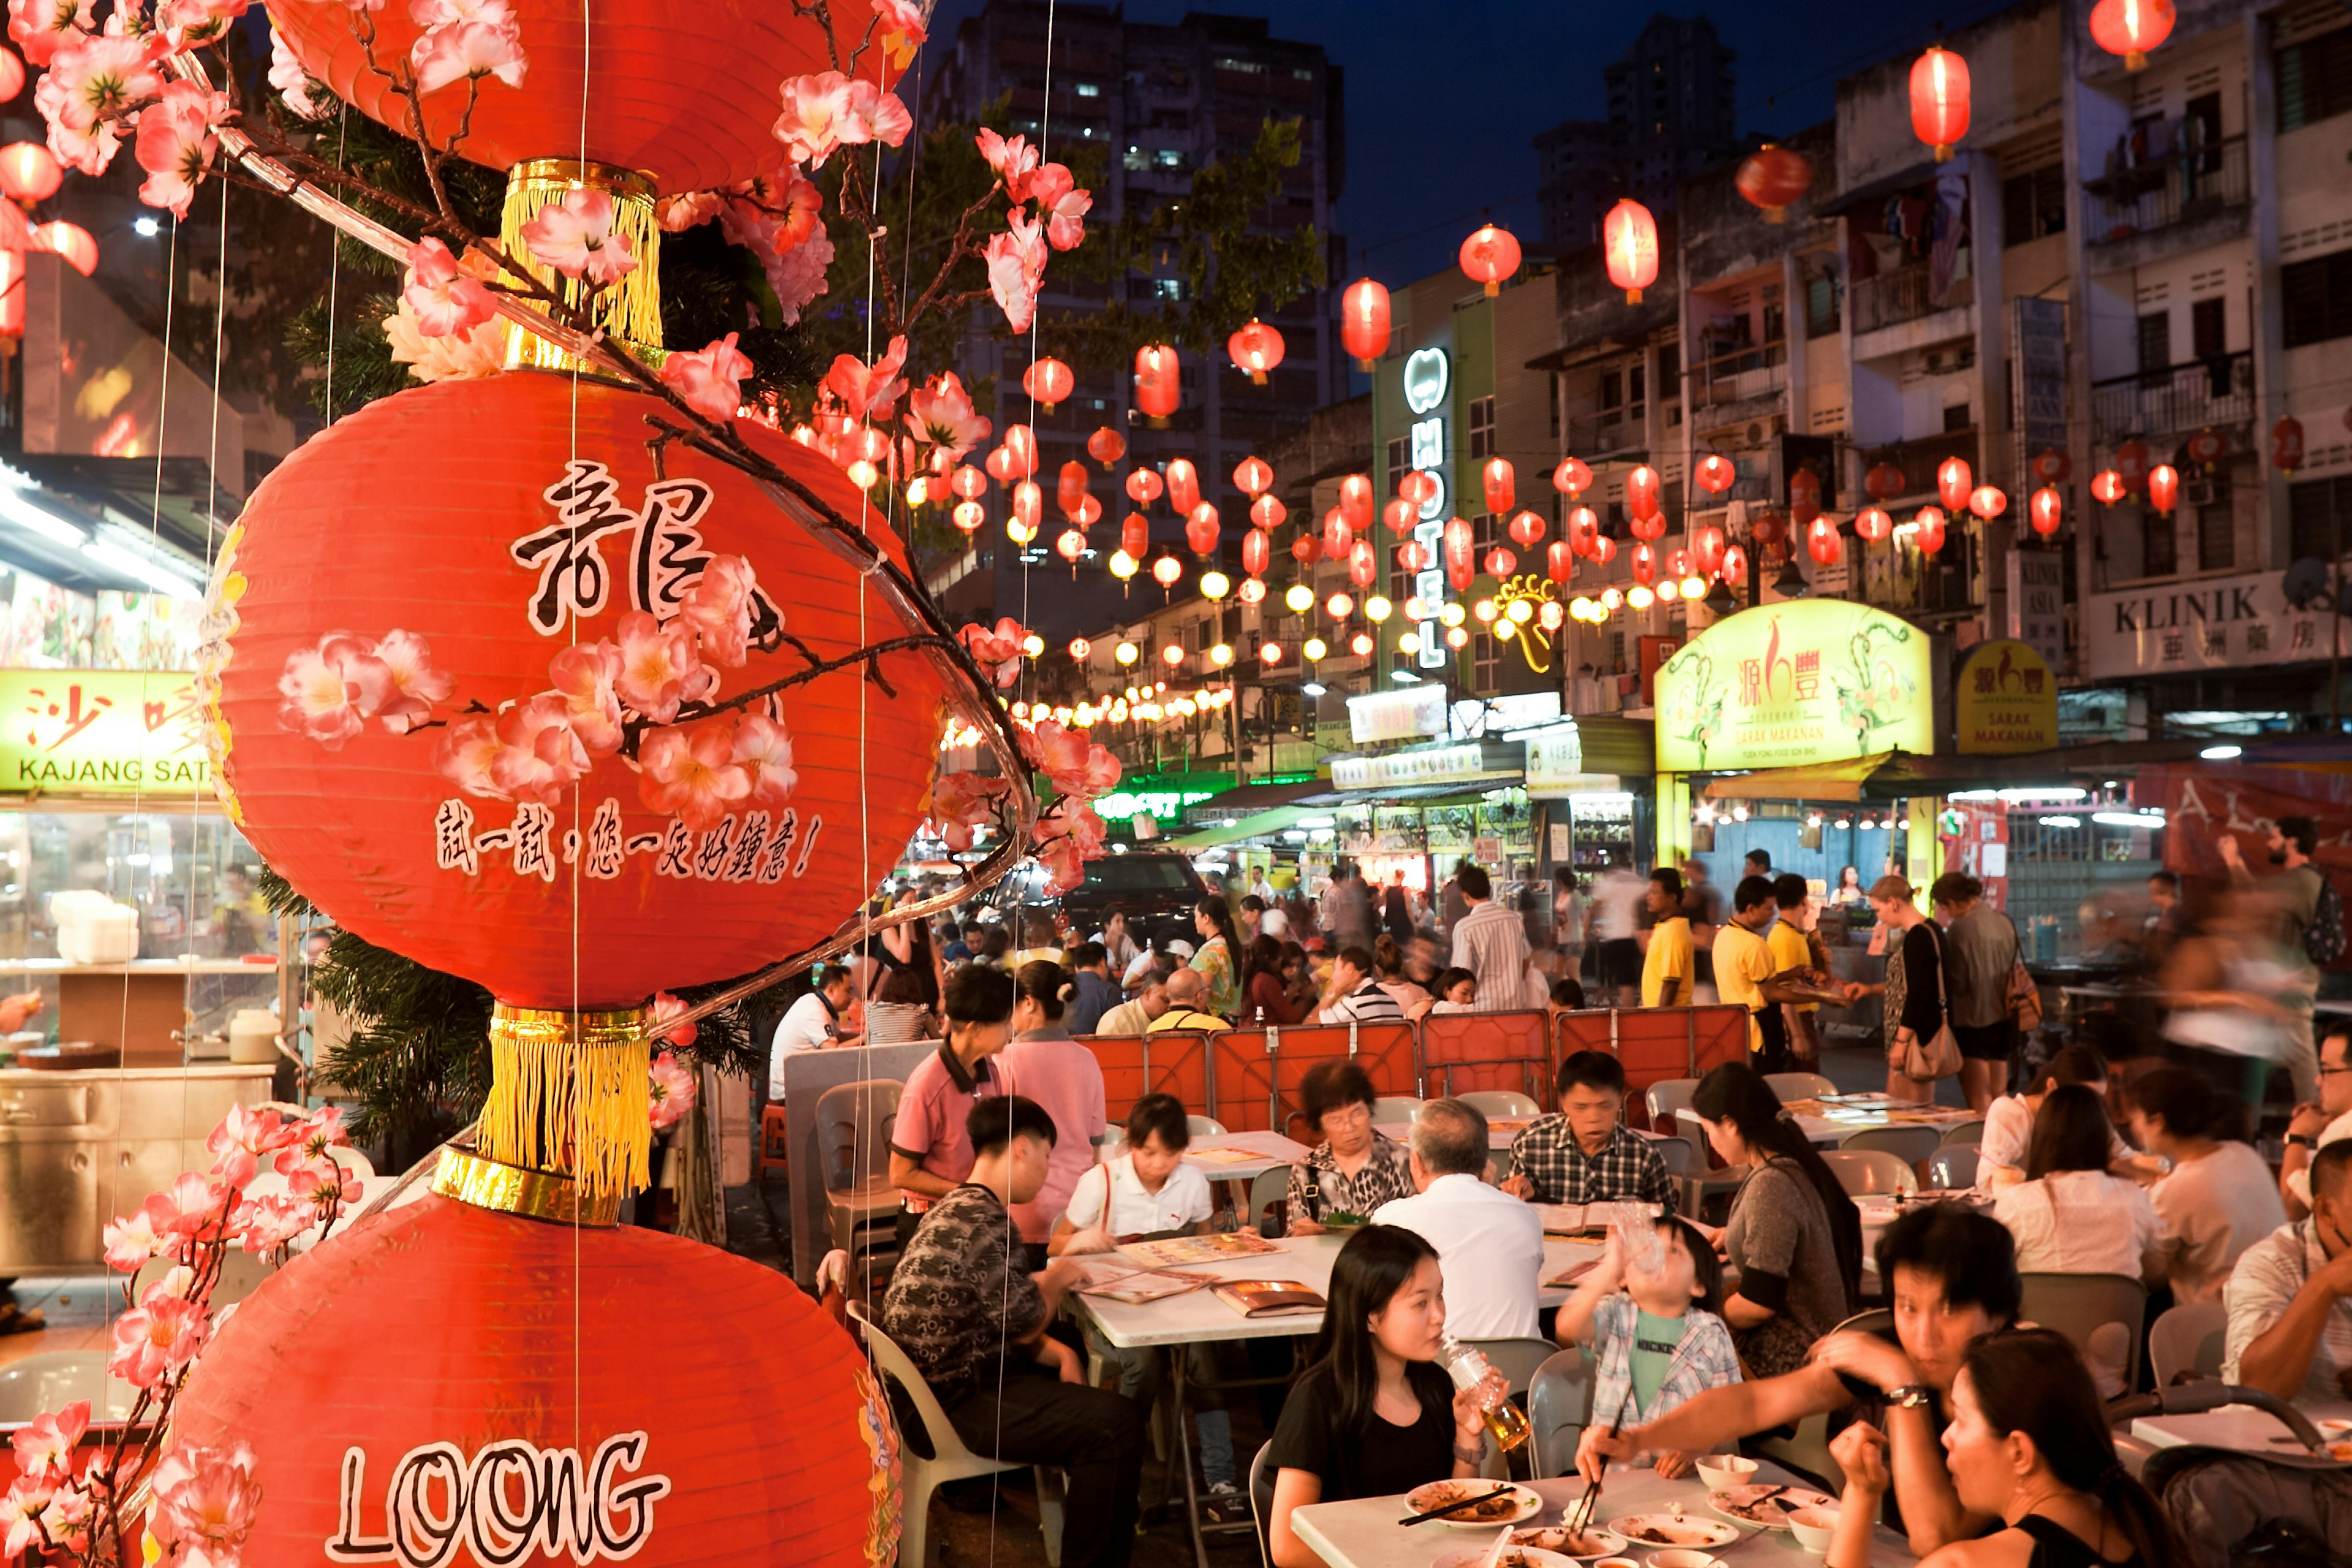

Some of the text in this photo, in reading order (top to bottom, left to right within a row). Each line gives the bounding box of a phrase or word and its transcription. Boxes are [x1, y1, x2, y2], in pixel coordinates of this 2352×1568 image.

[2114, 585, 2259, 633] KLINIK
[1770, 725, 1823, 741] MAKANAN
[1975, 730, 2044, 742] MAKANAN
[19, 760, 213, 781] KAJANG SAT
[327, 1429, 670, 1568] LOONG
